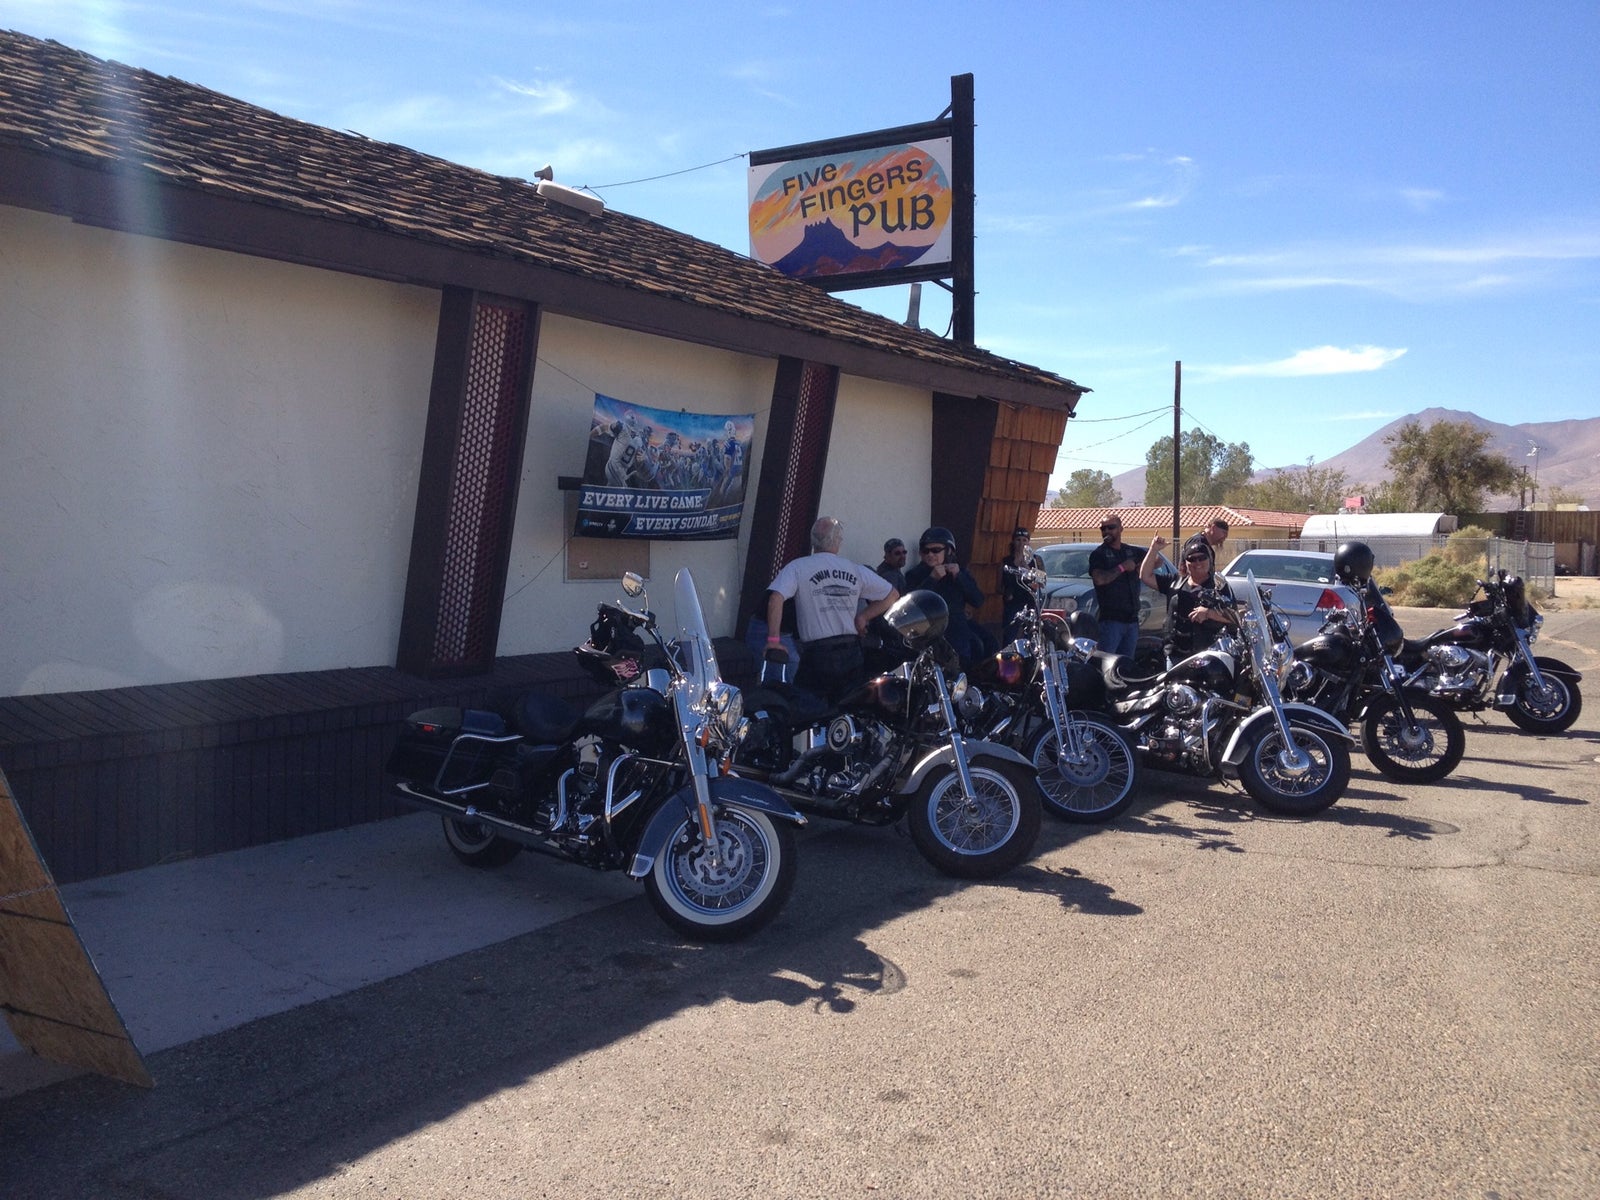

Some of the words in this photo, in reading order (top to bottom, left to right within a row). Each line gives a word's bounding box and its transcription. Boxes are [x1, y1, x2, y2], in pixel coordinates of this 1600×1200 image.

[582, 491, 635, 508] EVERY
[634, 495, 669, 509] LIVE
[635, 517, 680, 530] EVERY
[809, 569, 831, 585] TWIN
[832, 569, 857, 586] CITIES
